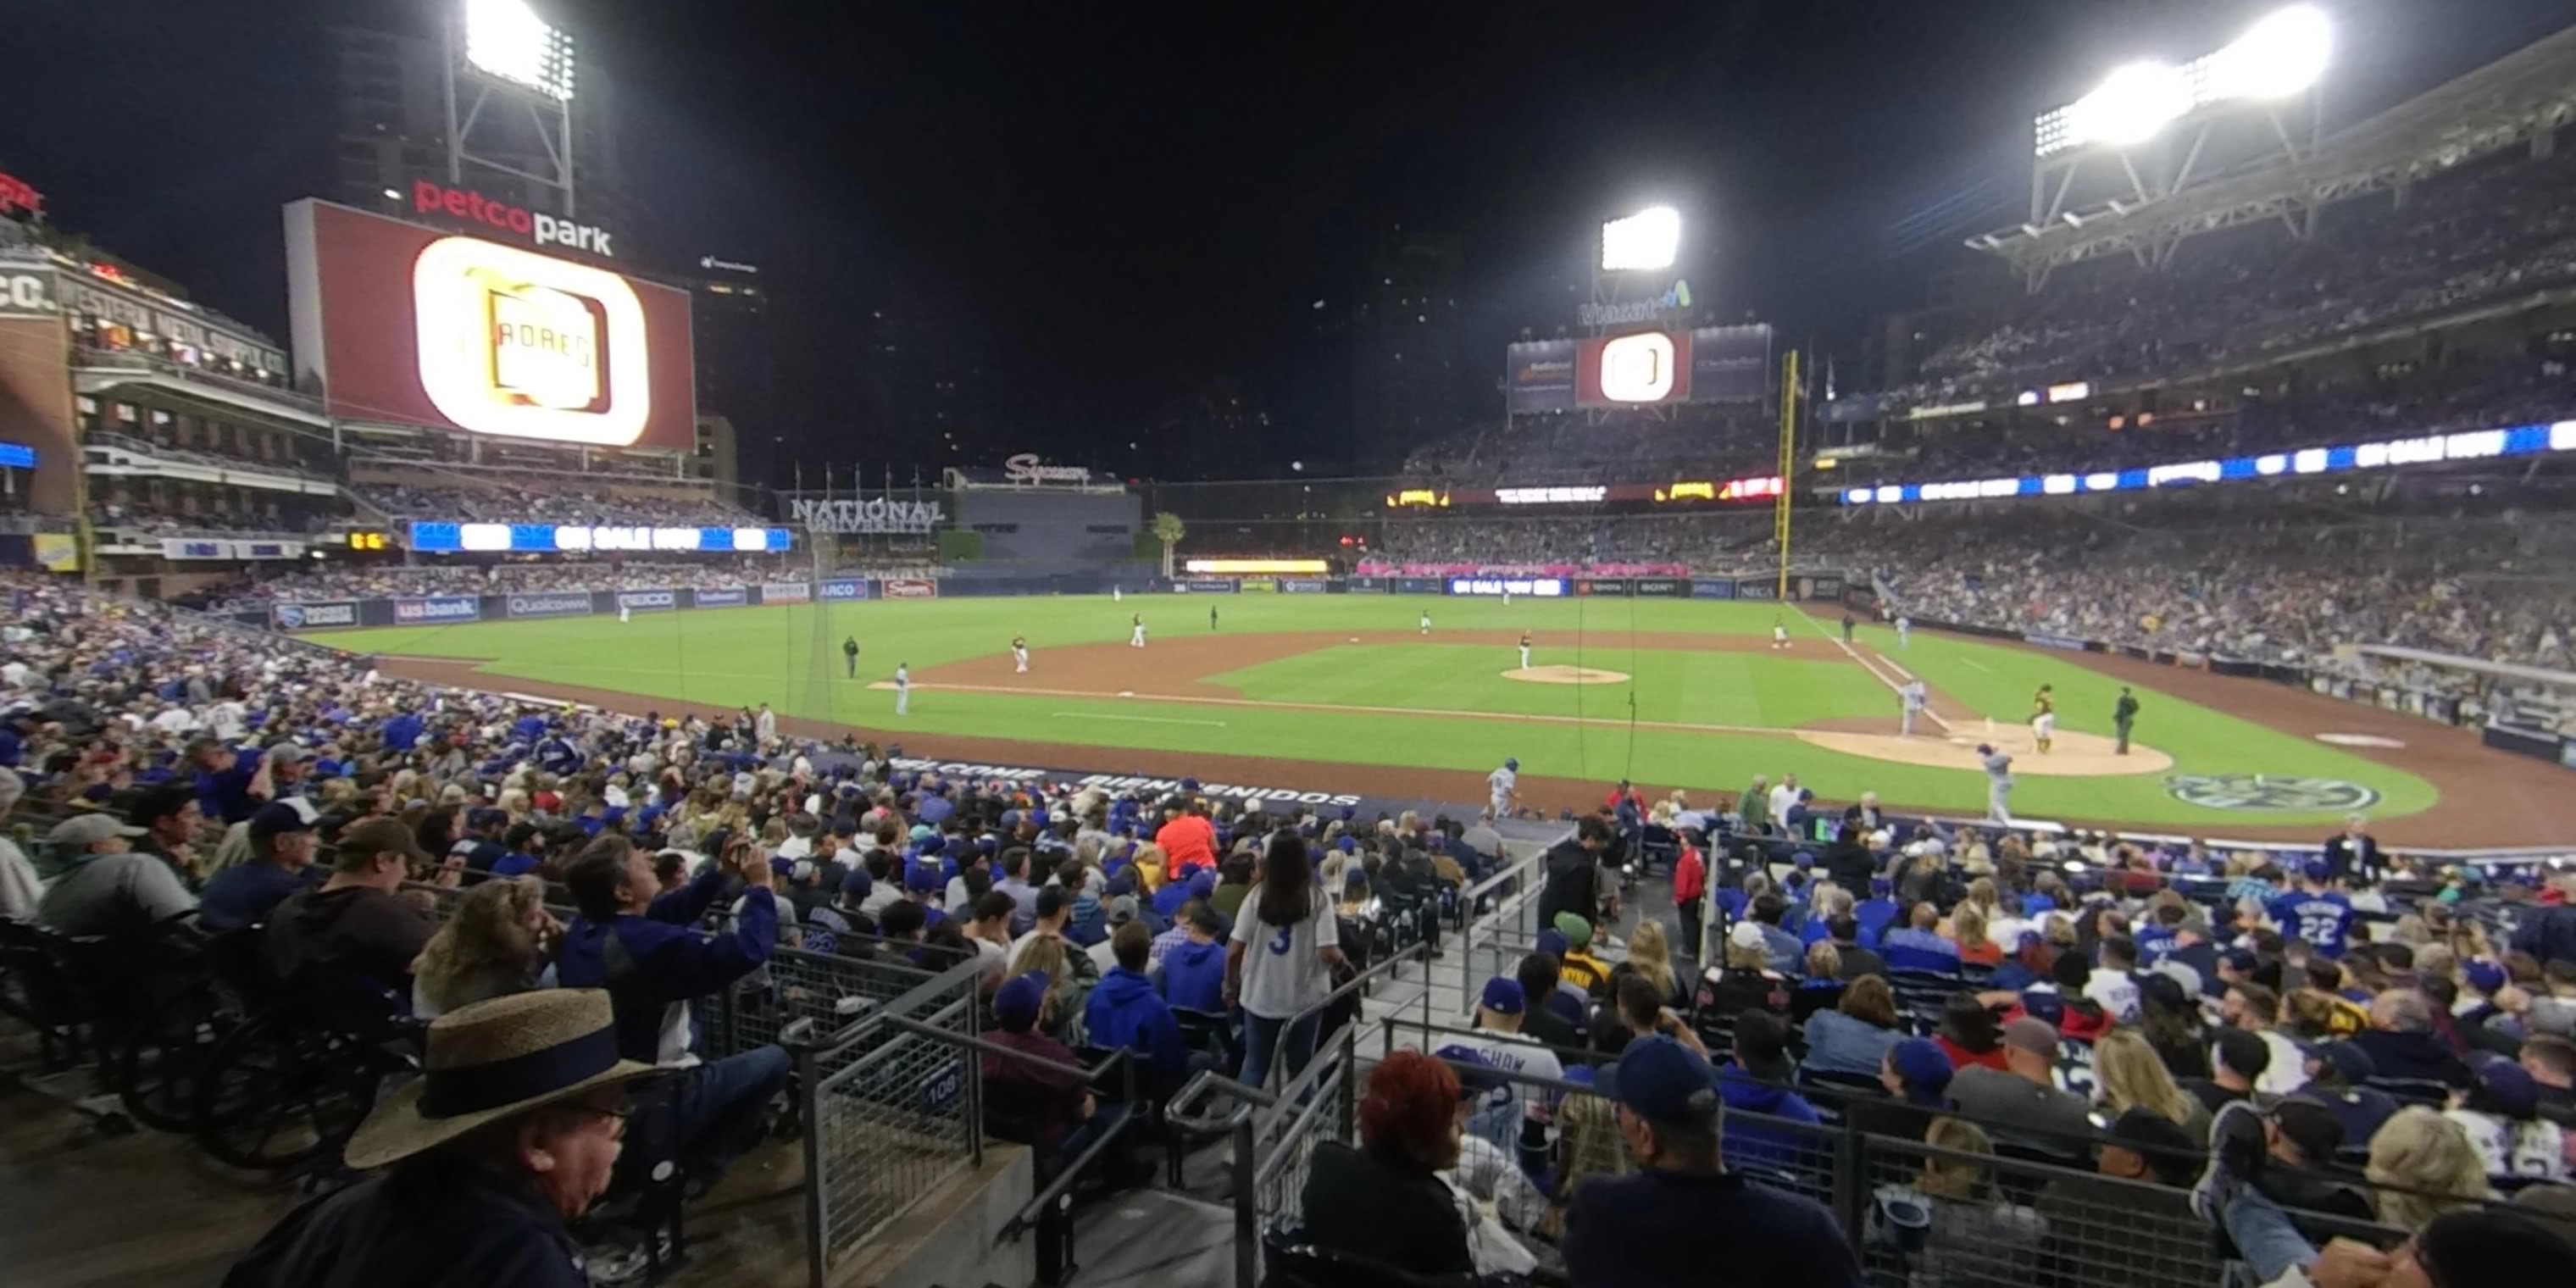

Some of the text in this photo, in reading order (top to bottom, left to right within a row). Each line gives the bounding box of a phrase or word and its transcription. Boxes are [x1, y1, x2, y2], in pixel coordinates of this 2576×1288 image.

[791, 499, 946, 521] NATIONAL
[819, 583, 854, 597] ARCO
[510, 597, 590, 613] Qualcomm
[1079, 774, 1362, 807] BIENENIDOS
[2300, 916, 2338, 946] 22
